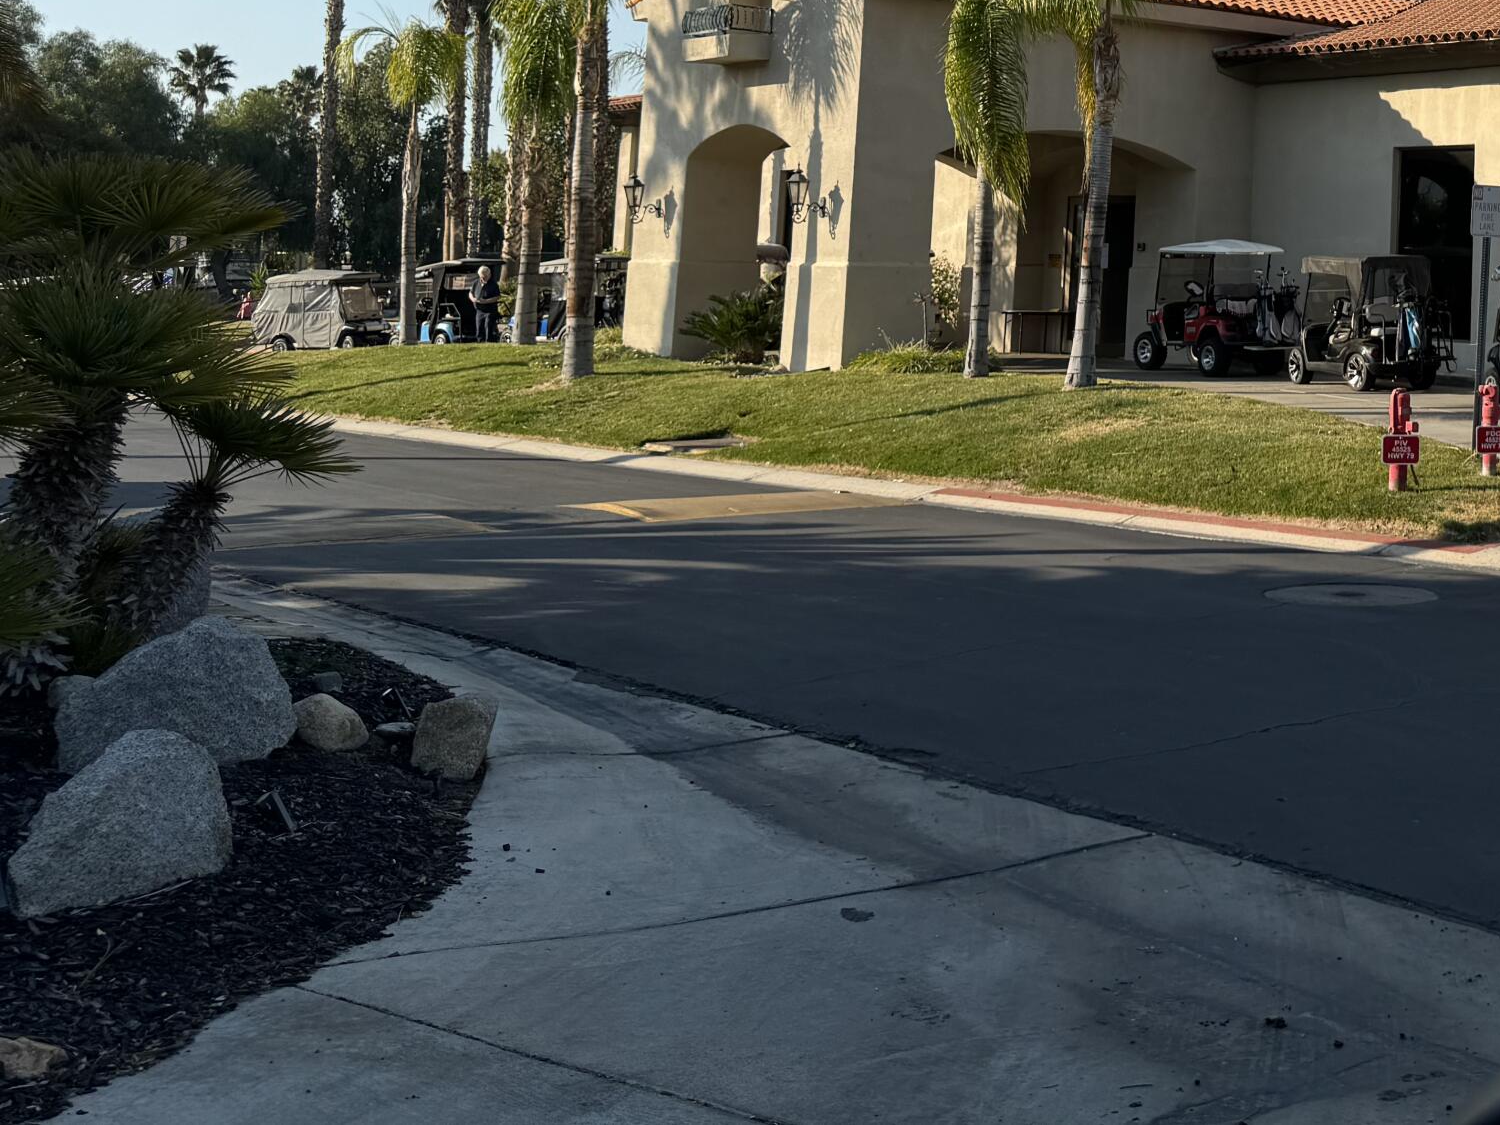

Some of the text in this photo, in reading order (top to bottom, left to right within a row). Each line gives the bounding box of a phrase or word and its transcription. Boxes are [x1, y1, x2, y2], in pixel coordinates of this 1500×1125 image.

[1481, 213, 1496, 222] FIRE
[1479, 222, 1495, 231] LANE
[1481, 442, 1497, 450] HWY
